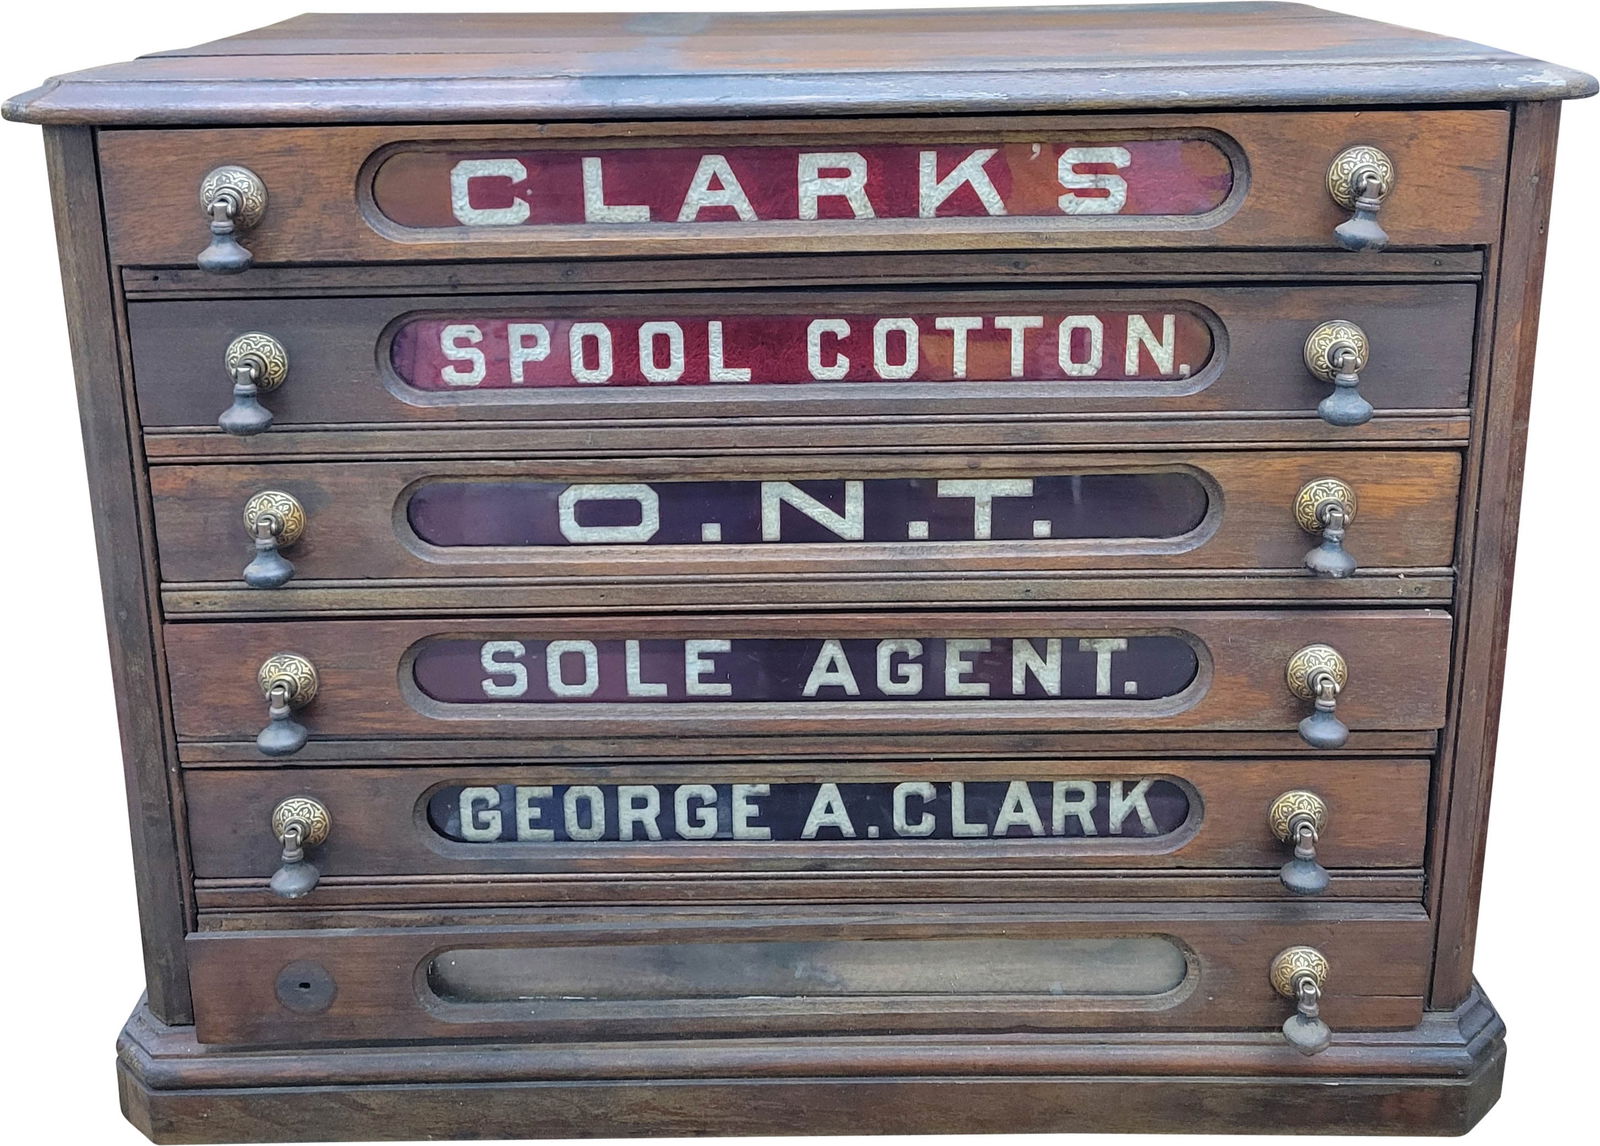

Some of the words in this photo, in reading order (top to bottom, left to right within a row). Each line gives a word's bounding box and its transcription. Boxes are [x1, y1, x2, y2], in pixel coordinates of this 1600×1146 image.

[450, 143, 1132, 226] CLARK'S
[440, 320, 752, 387] SPOOL
[806, 312, 1192, 381] COTTON.
[480, 638, 734, 700] SOLE
[803, 637, 1138, 698] AGENT.
[459, 783, 773, 842] GEORGE
